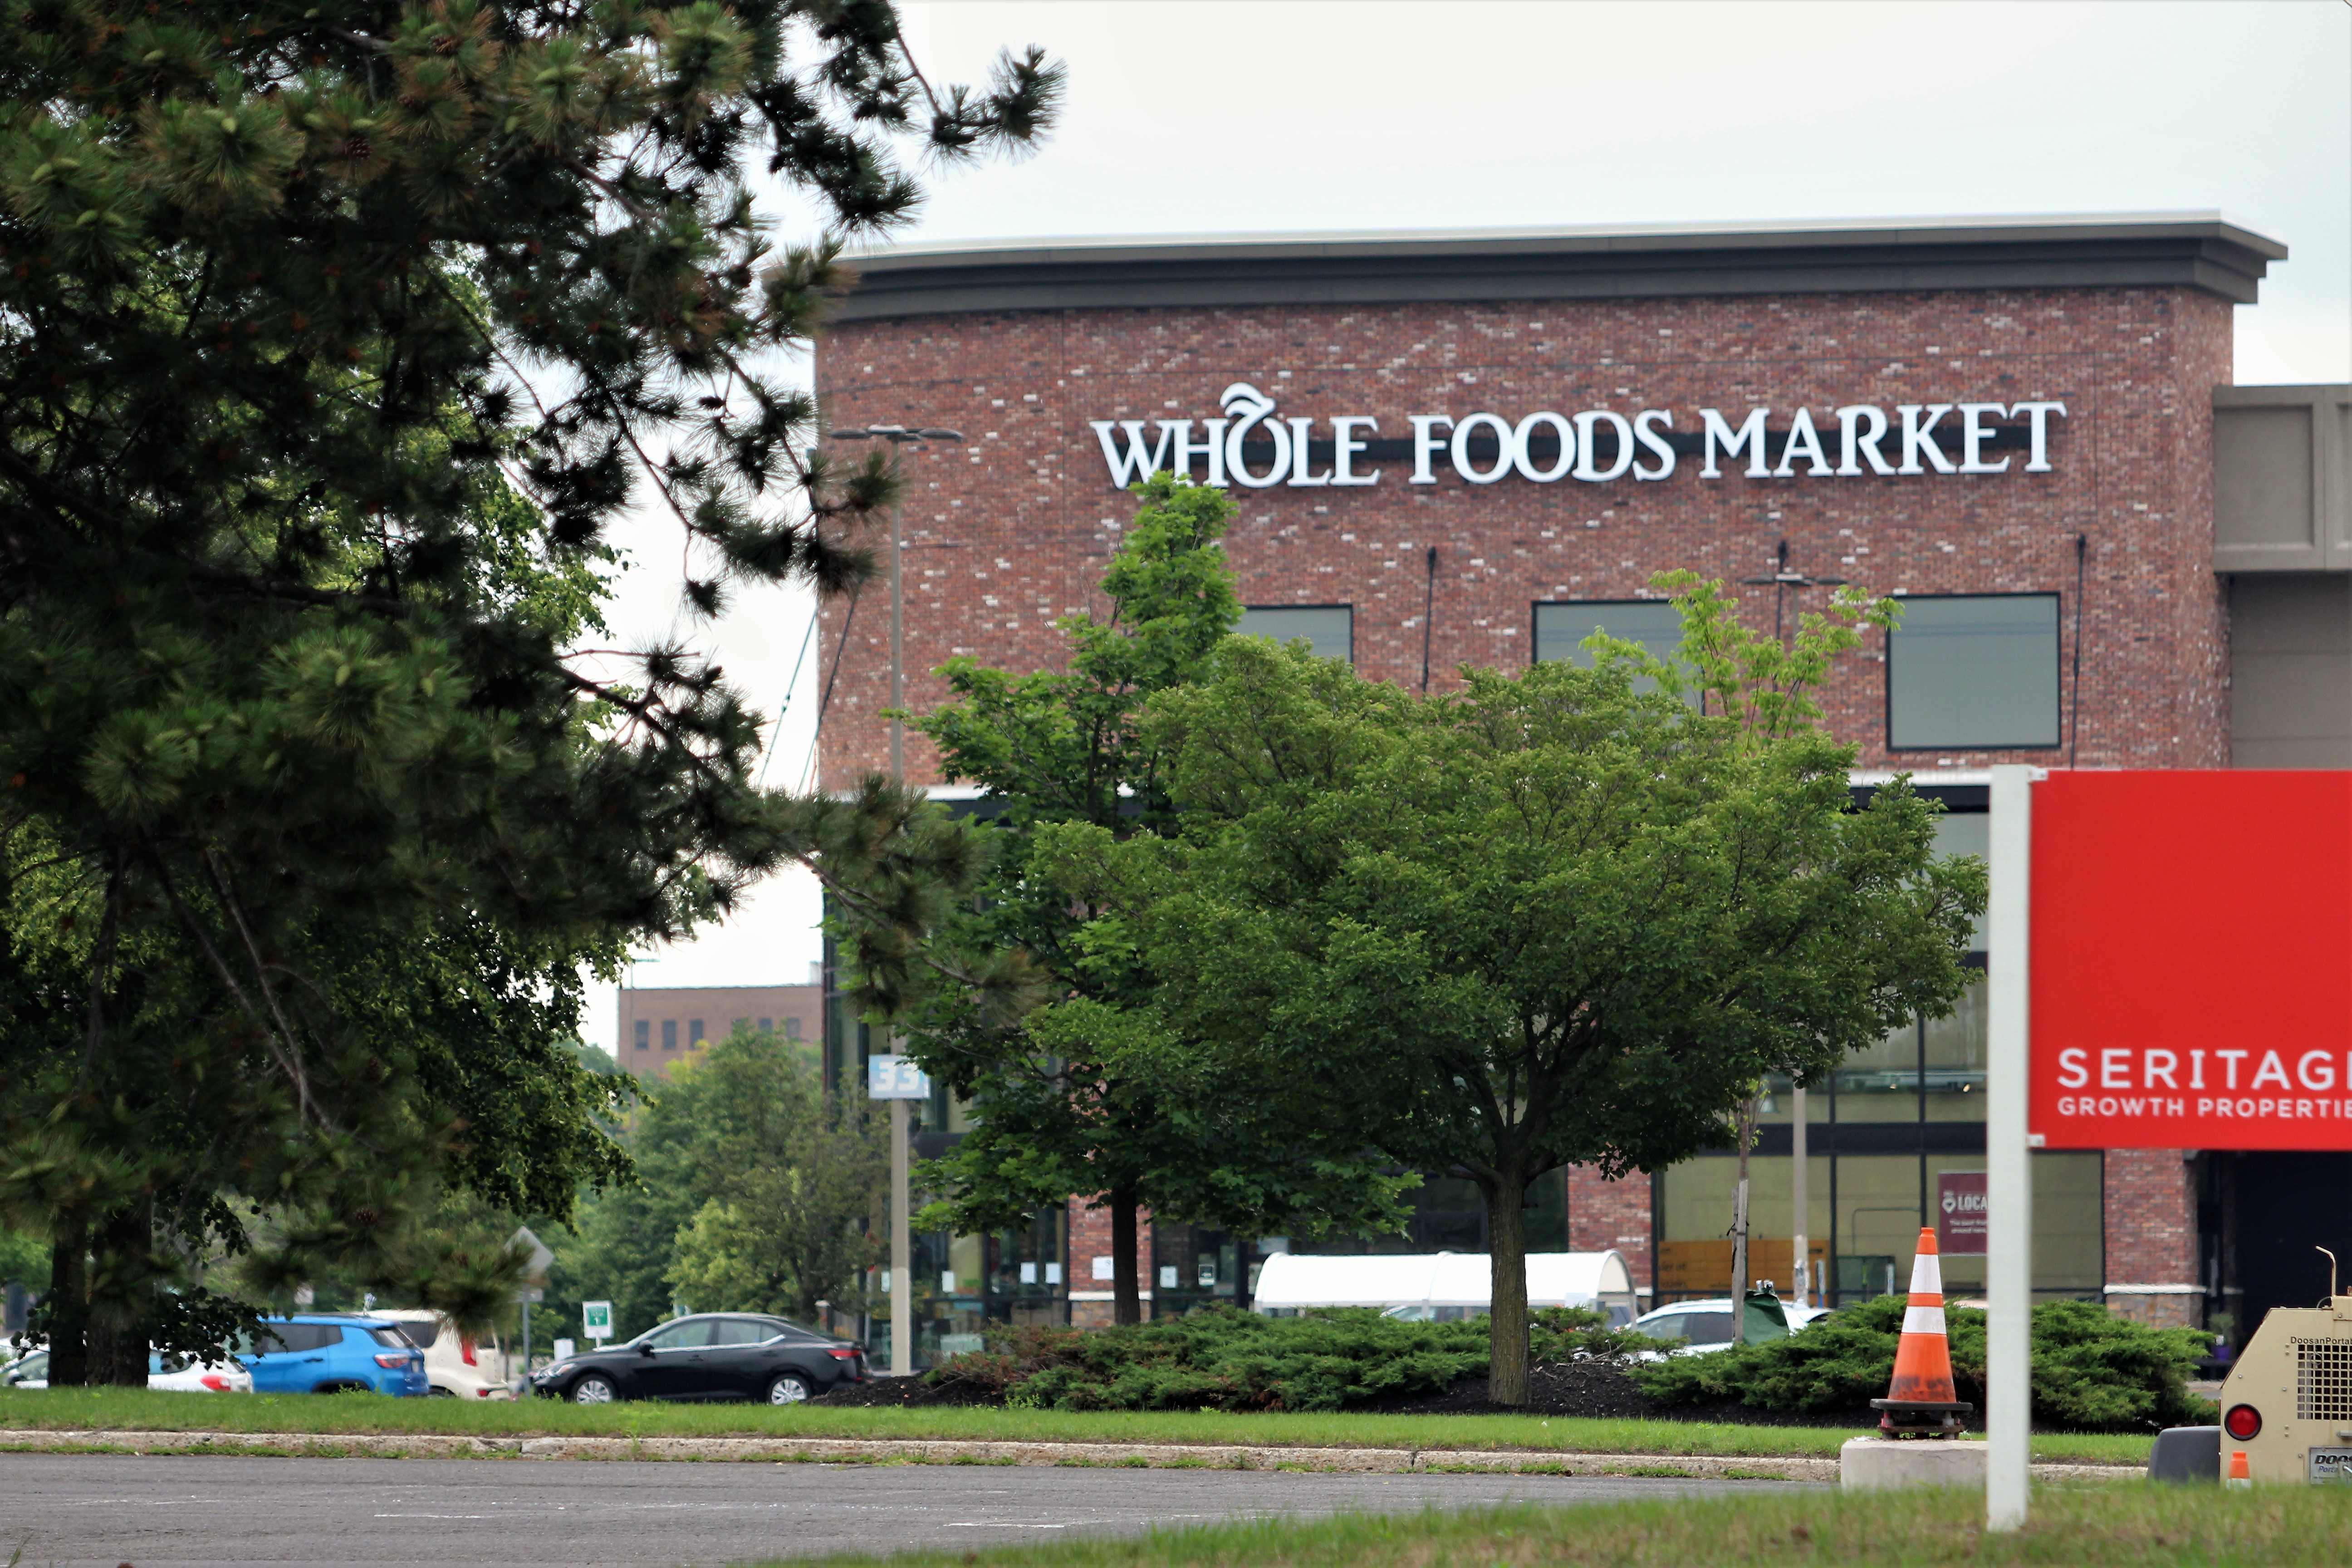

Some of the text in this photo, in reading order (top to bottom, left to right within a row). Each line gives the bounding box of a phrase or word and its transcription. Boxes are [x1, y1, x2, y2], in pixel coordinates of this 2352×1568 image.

[1089, 382, 2068, 490] WHOLE FOODS MARKET
[874, 1062, 920, 1091] 33
[2057, 1048, 2352, 1091] SERITAG
[2057, 1096, 2184, 1117] GROWTH
